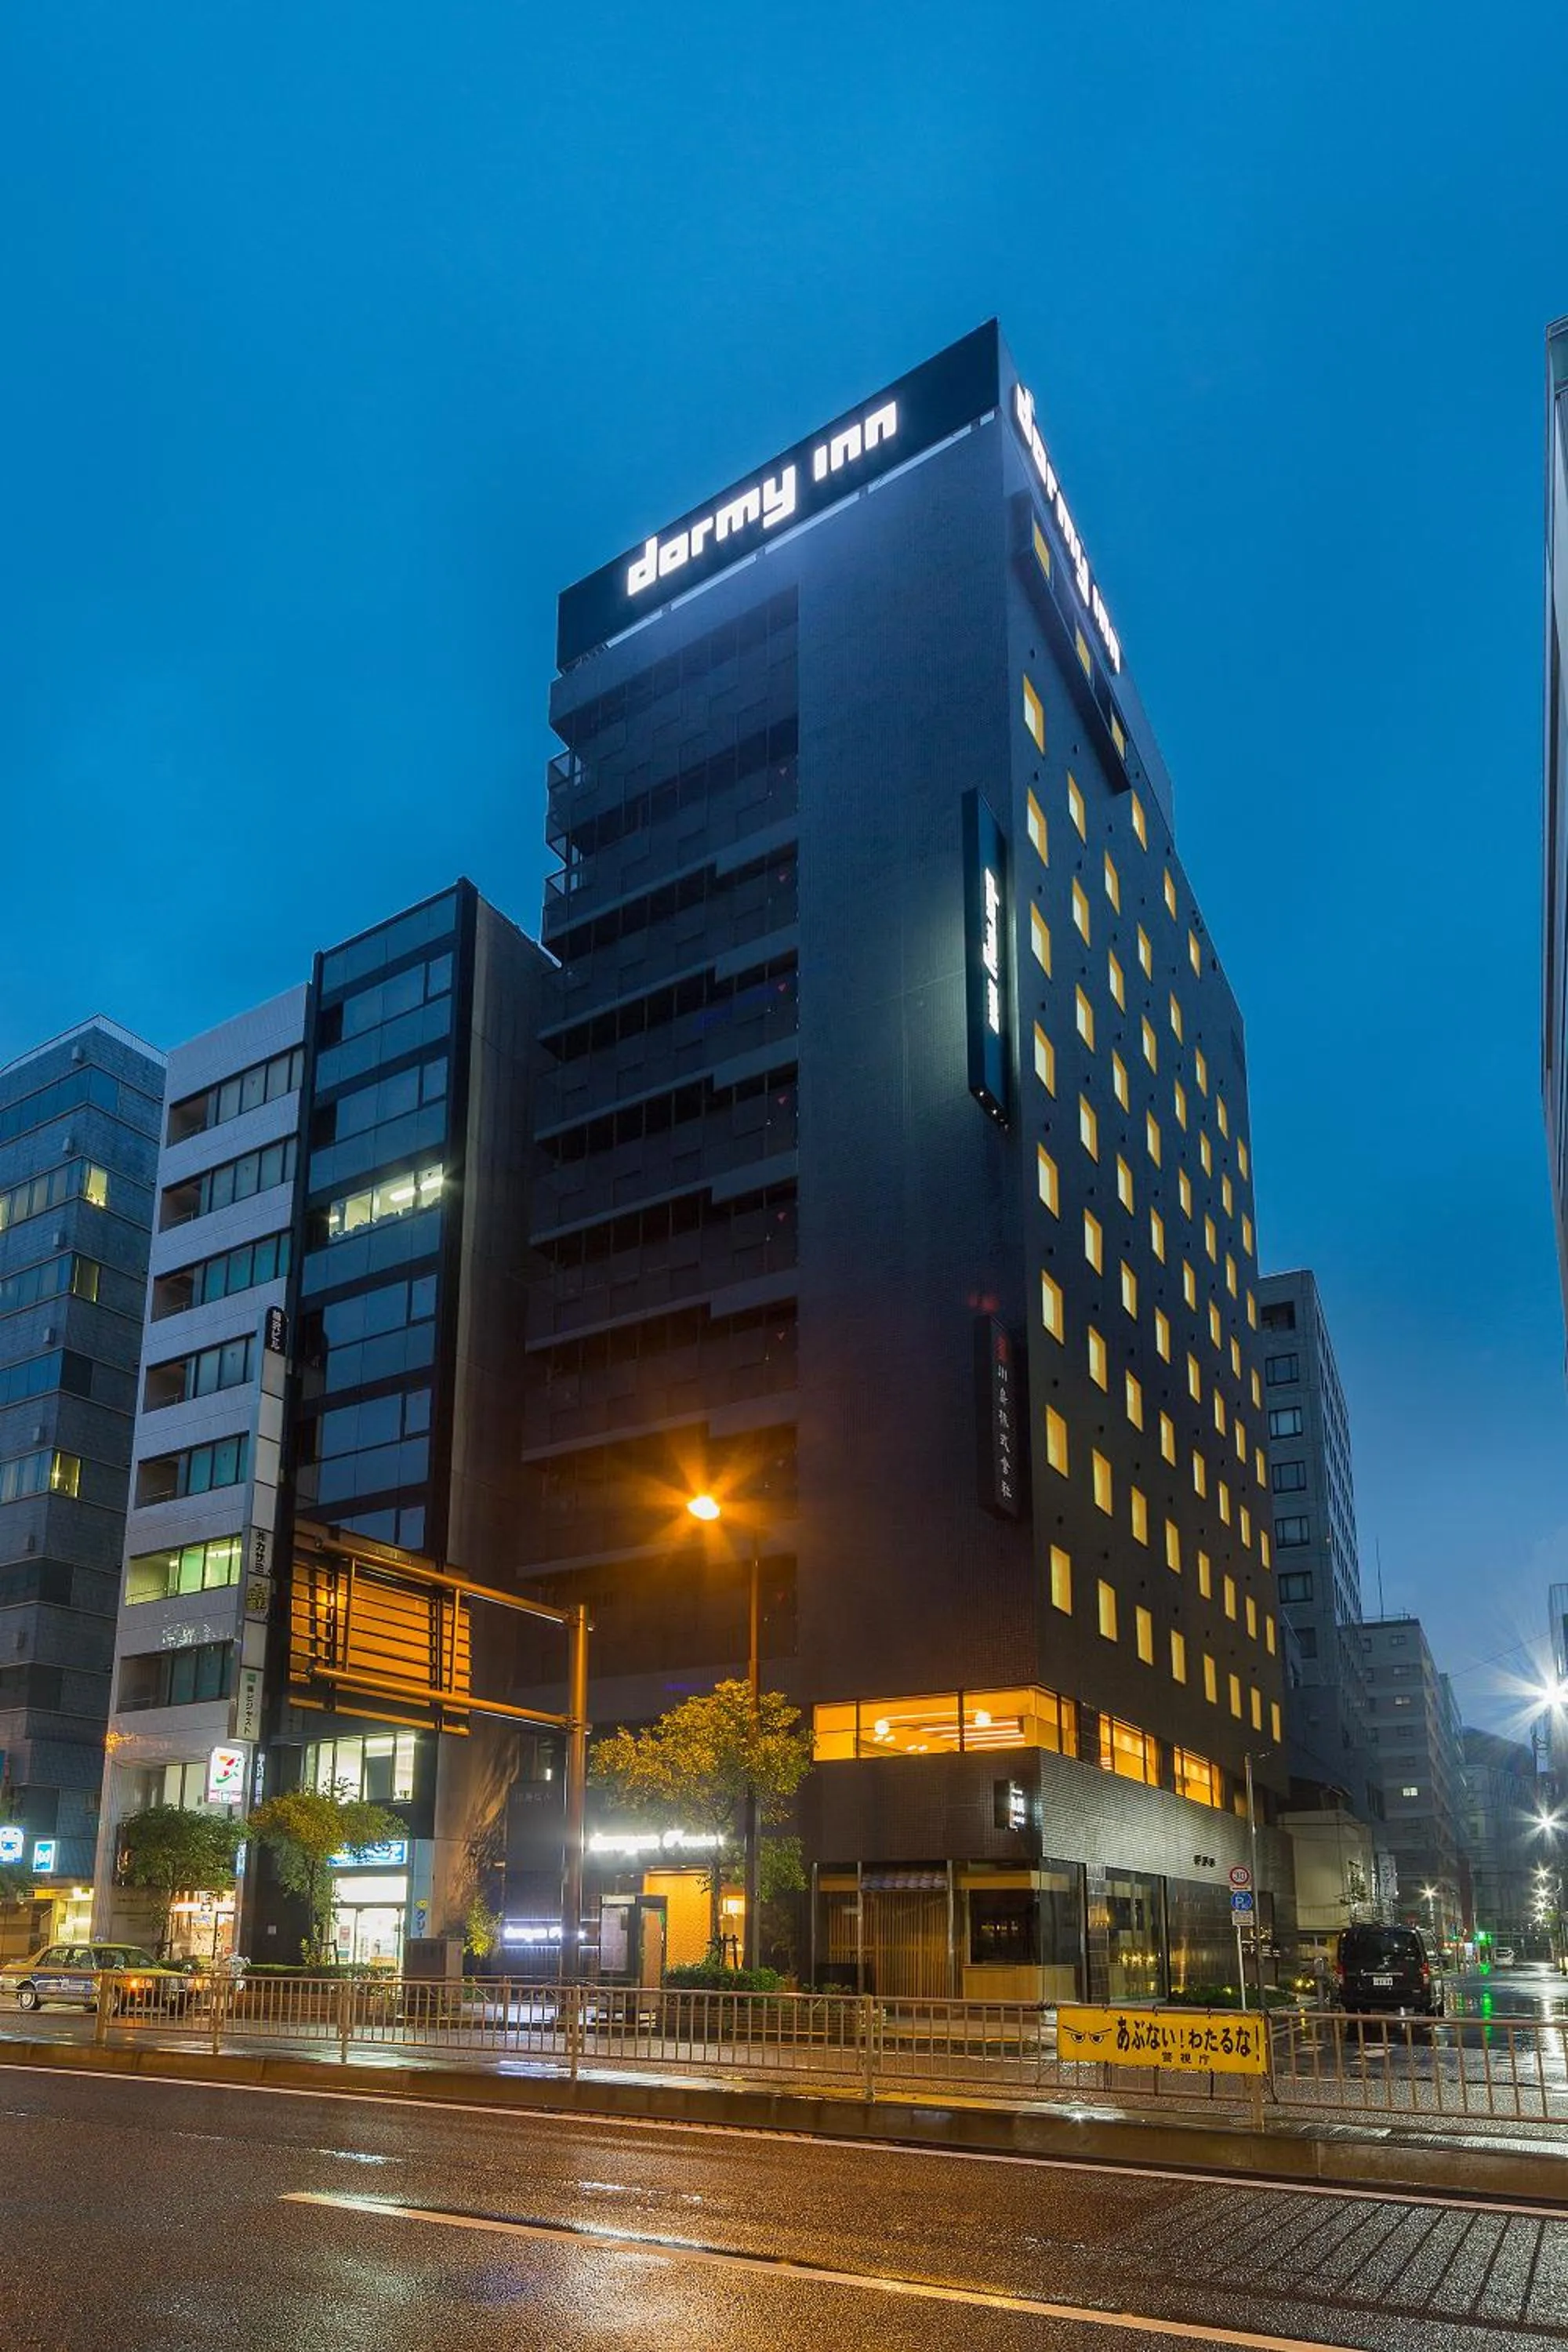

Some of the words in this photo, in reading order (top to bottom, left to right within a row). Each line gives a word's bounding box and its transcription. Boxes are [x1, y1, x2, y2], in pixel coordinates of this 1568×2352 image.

[626, 465, 796, 597] dormy
[813, 401, 898, 482] inn
[1161, 2051, 1210, 2066] 警視庁
